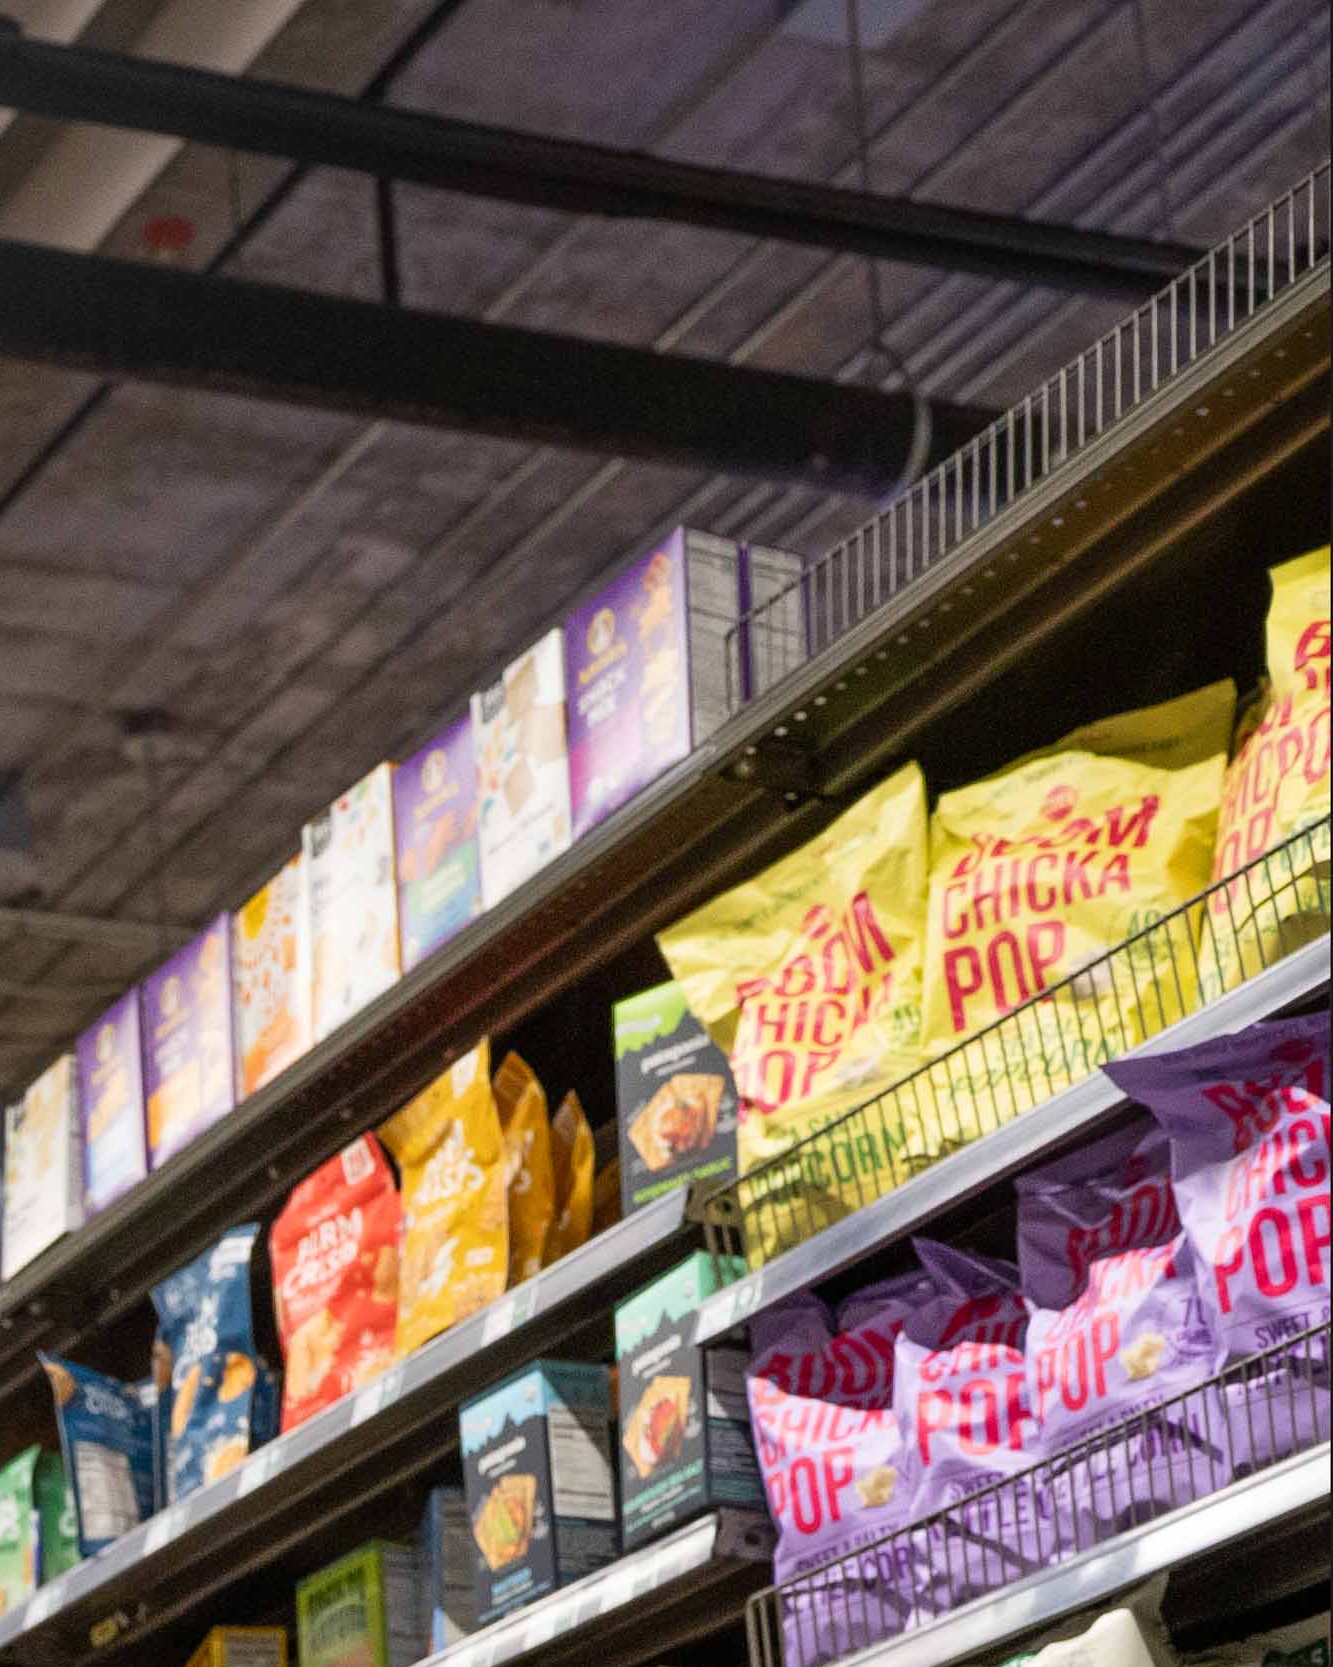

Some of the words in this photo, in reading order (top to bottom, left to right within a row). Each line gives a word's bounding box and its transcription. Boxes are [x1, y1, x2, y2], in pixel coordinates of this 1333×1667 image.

[941, 847, 1132, 941] CHICKA
[943, 919, 1066, 1034] POP
[1224, 1112, 1330, 1222] CHIC
[1211, 1193, 1330, 1314] POP
[1035, 1310, 1122, 1427] POP
